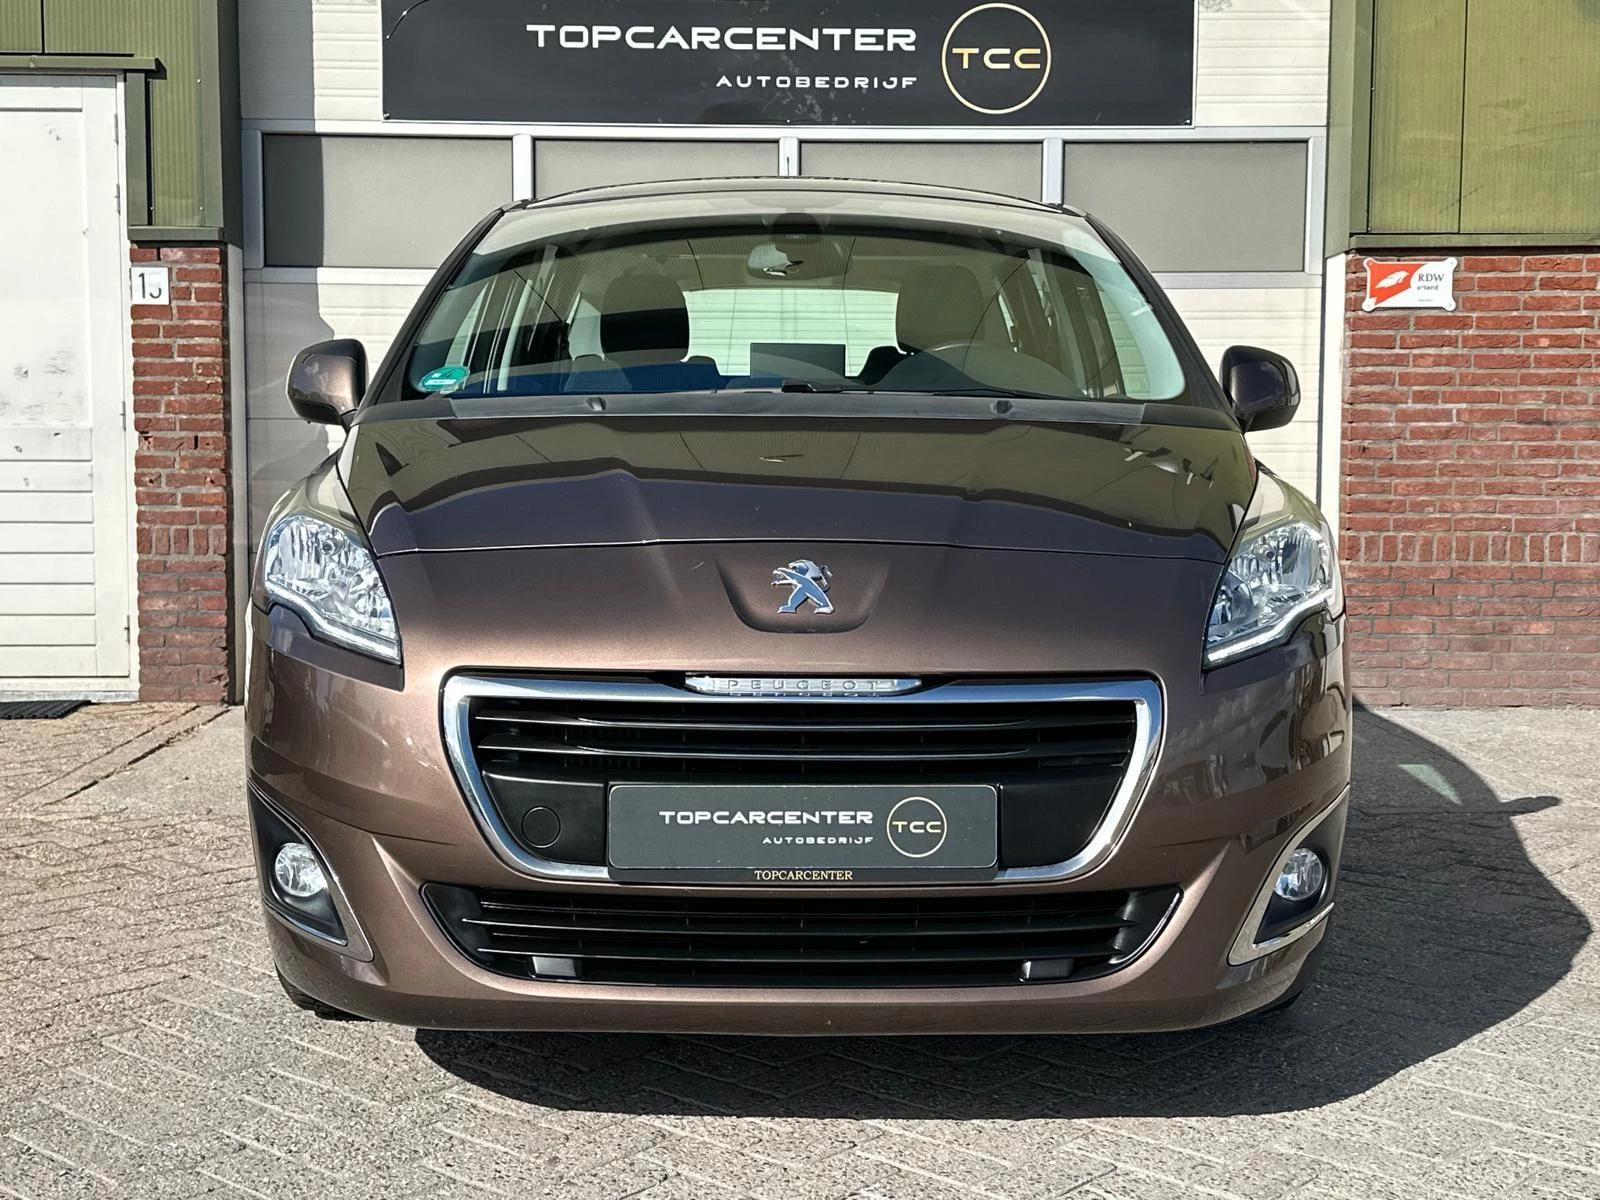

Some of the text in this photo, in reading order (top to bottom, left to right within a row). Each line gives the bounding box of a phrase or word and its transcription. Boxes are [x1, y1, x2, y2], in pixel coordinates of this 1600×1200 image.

[526, 24, 917, 52] TOPCARCENTER
[952, 47, 1041, 70] TCC
[716, 75, 917, 90] AUTOBEDRIJF
[1417, 273, 1445, 282] RDW
[727, 679, 879, 691] PEUGEOT
[658, 810, 874, 825] TOPCARCENTER
[891, 820, 943, 834] TCC
[762, 836, 874, 845] AUTOBEDRIJF
[753, 870, 854, 881] TOPCARCENTER
